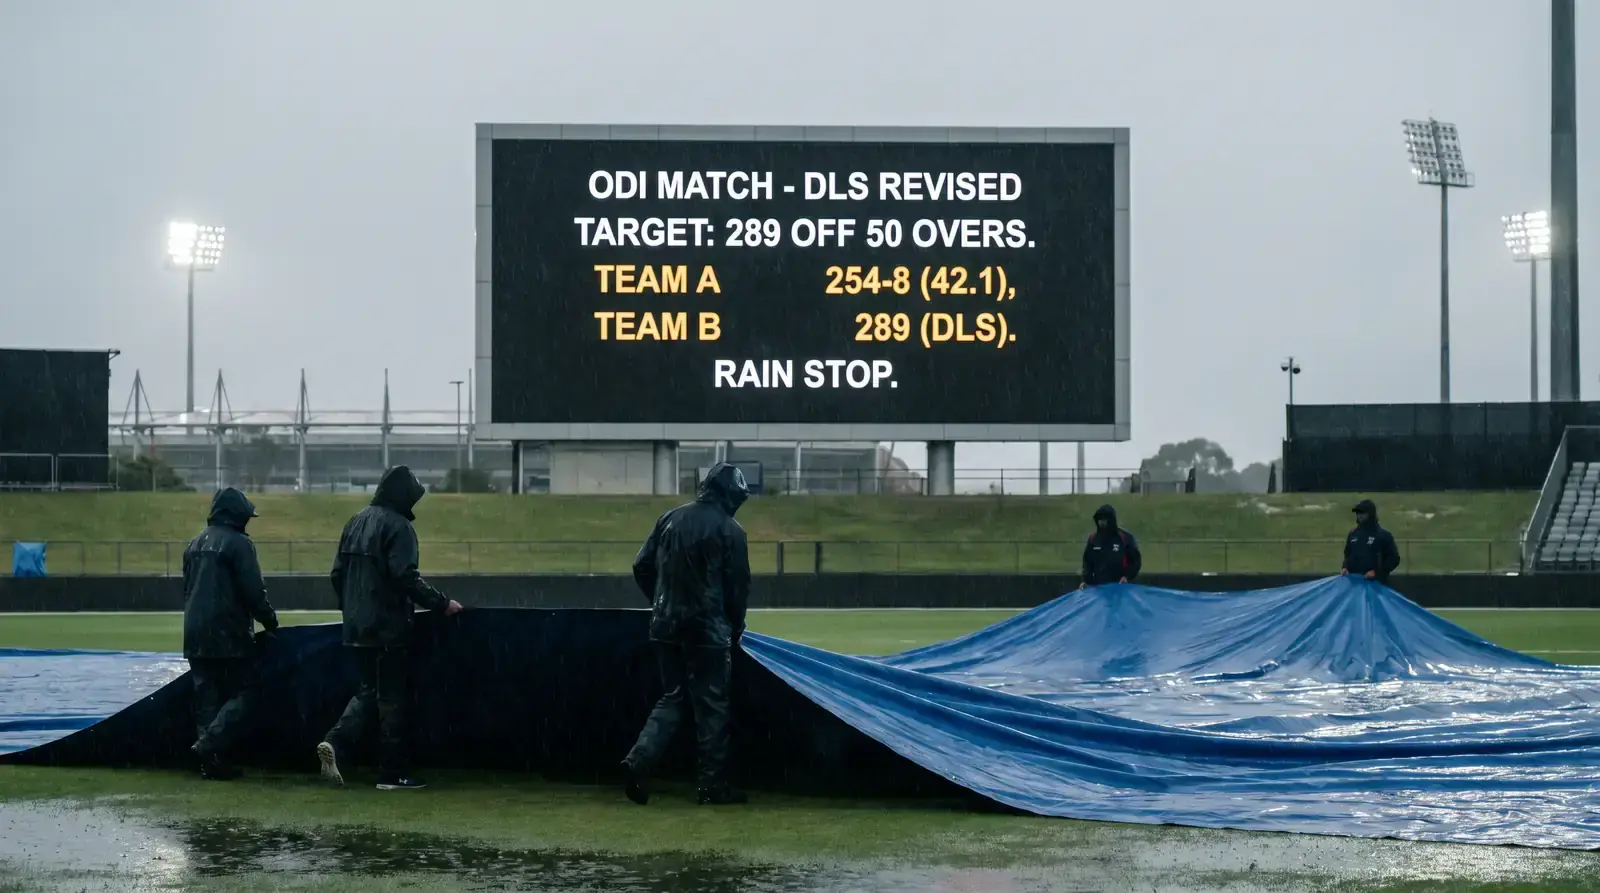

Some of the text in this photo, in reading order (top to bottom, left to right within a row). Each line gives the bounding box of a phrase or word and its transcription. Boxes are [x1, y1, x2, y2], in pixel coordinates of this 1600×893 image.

[589, 170, 646, 199] ODI
[658, 171, 772, 200] MATCH
[805, 172, 869, 200] DLS
[880, 172, 1021, 200] REVISED
[574, 217, 1035, 248] TARGET: 289 OFF 50 OVERS.
[594, 265, 1016, 301] TEAM A 254-8 (42.1),
[594, 312, 1016, 348] TEAM B 289 (DLS).
[715, 360, 897, 388] RAIN STOP.
